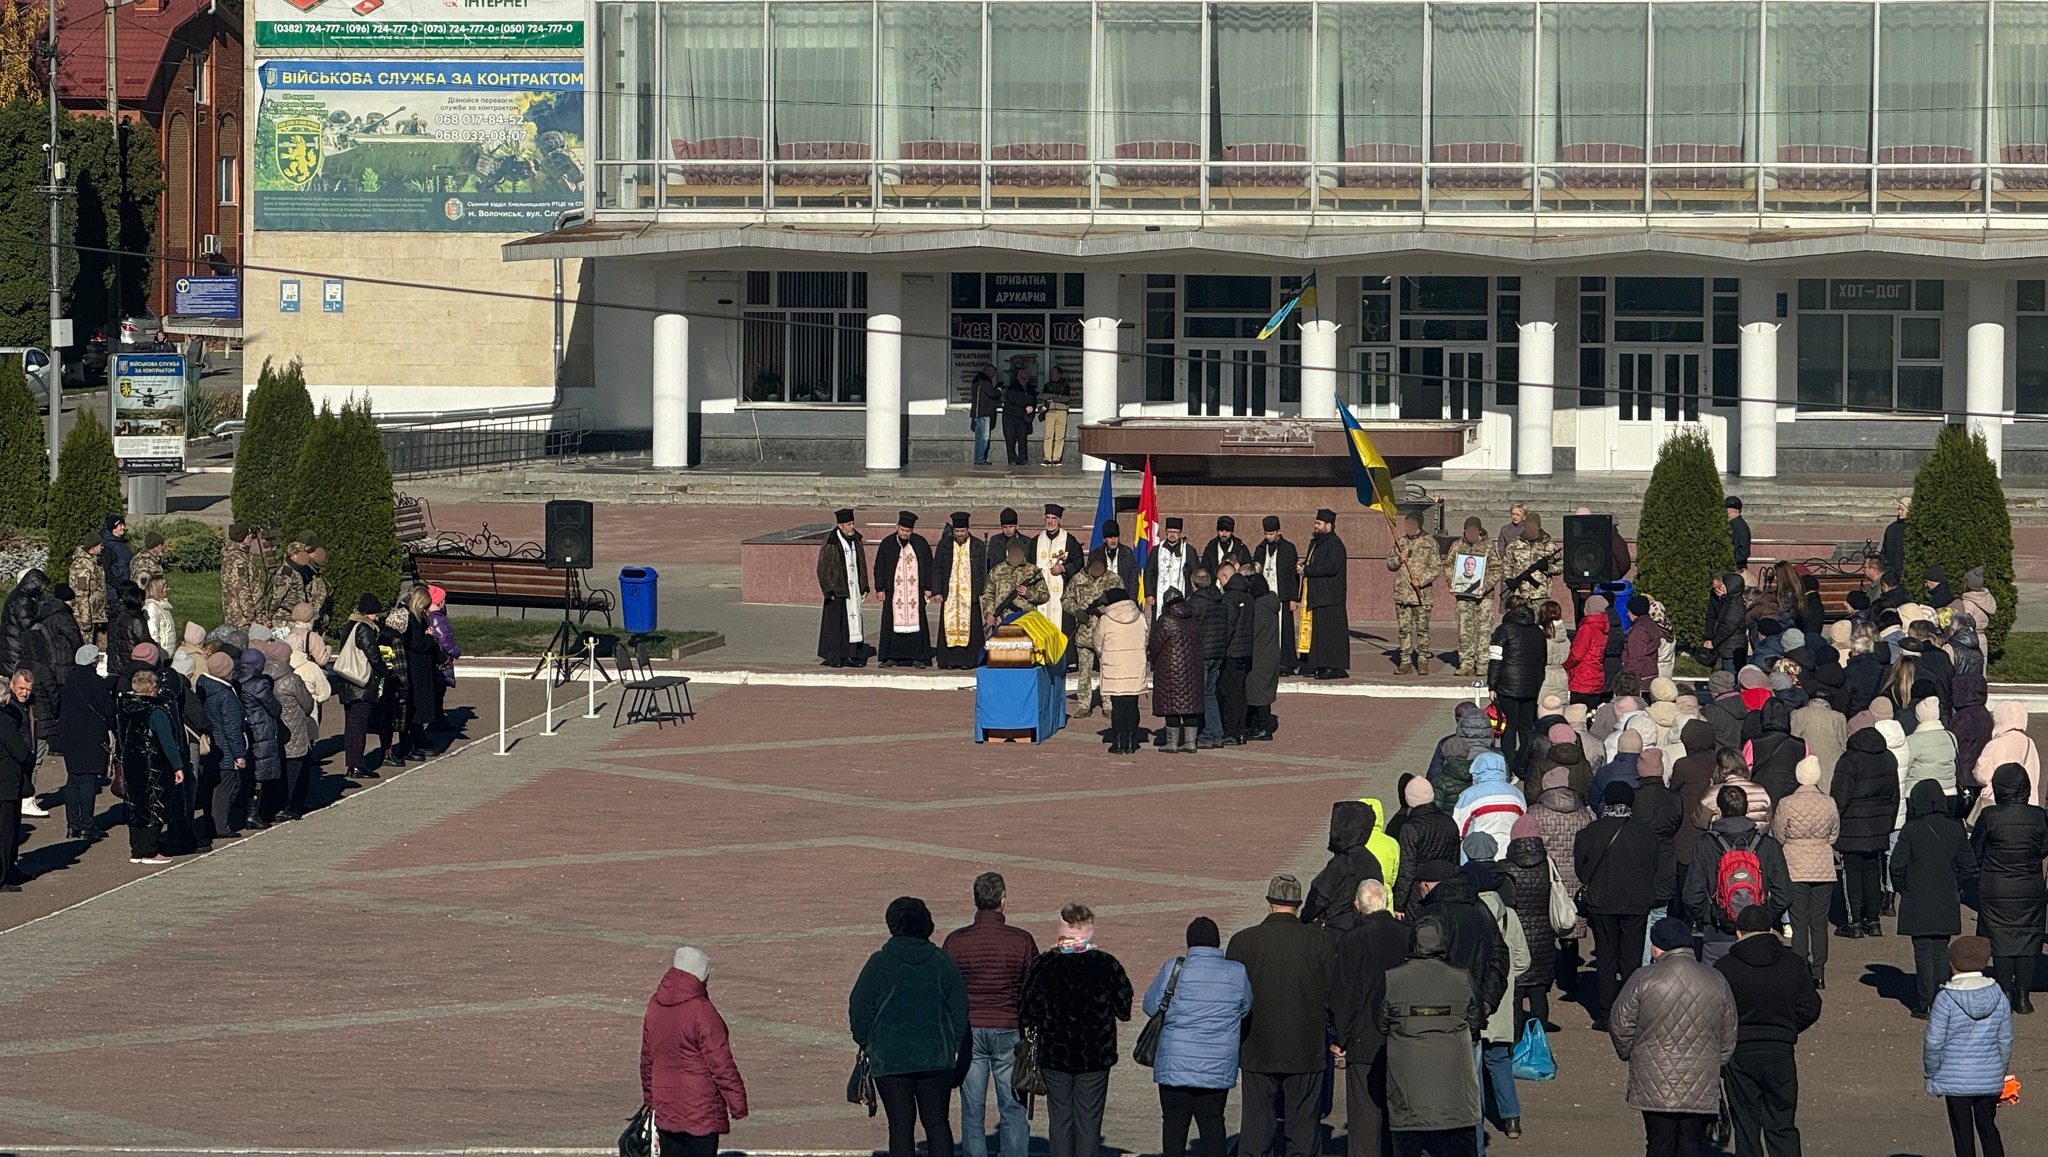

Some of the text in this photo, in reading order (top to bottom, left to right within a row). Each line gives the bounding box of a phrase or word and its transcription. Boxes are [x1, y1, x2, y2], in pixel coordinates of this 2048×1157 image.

[273, 24, 573, 34] (0382) 724-777 (096) 724-777-0 (073) 724-777-0 (050) 724-777-0
[282, 70, 583, 85] ВІЙСЬКОВА СЛУЖБА ЗА КОНТРАКТОМ
[435, 114, 527, 125] 068 017-84-52,
[435, 130, 527, 141] 068 032-08-07
[479, 210, 524, 218] Волочиськ,
[526, 211, 542, 219] вул.
[995, 275, 1046, 285] ПРИВАТНА
[1839, 284, 1904, 299] ХОТ-ДОГ
[995, 292, 1046, 303] ДРУКАРНЯ
